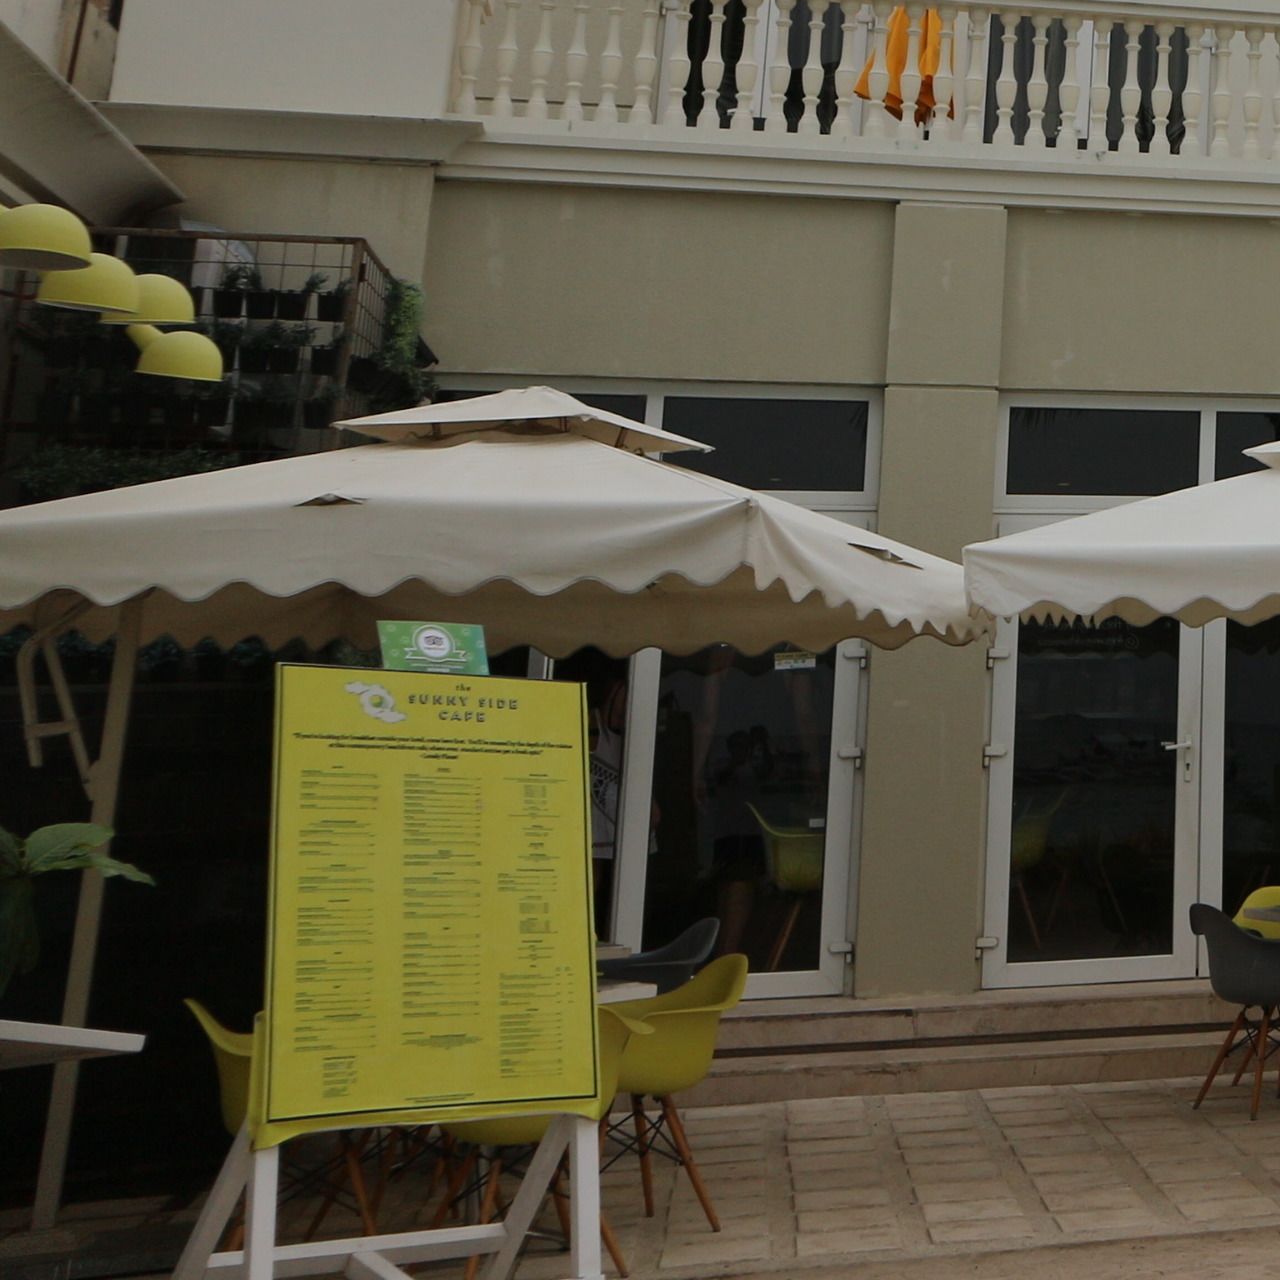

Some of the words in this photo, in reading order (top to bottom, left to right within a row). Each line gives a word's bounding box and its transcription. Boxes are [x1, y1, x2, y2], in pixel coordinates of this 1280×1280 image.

[455, 683, 471, 693] the
[408, 693, 468, 708] SUNNY
[478, 698, 519, 710] SIDE
[438, 710, 487, 724] CAFE
